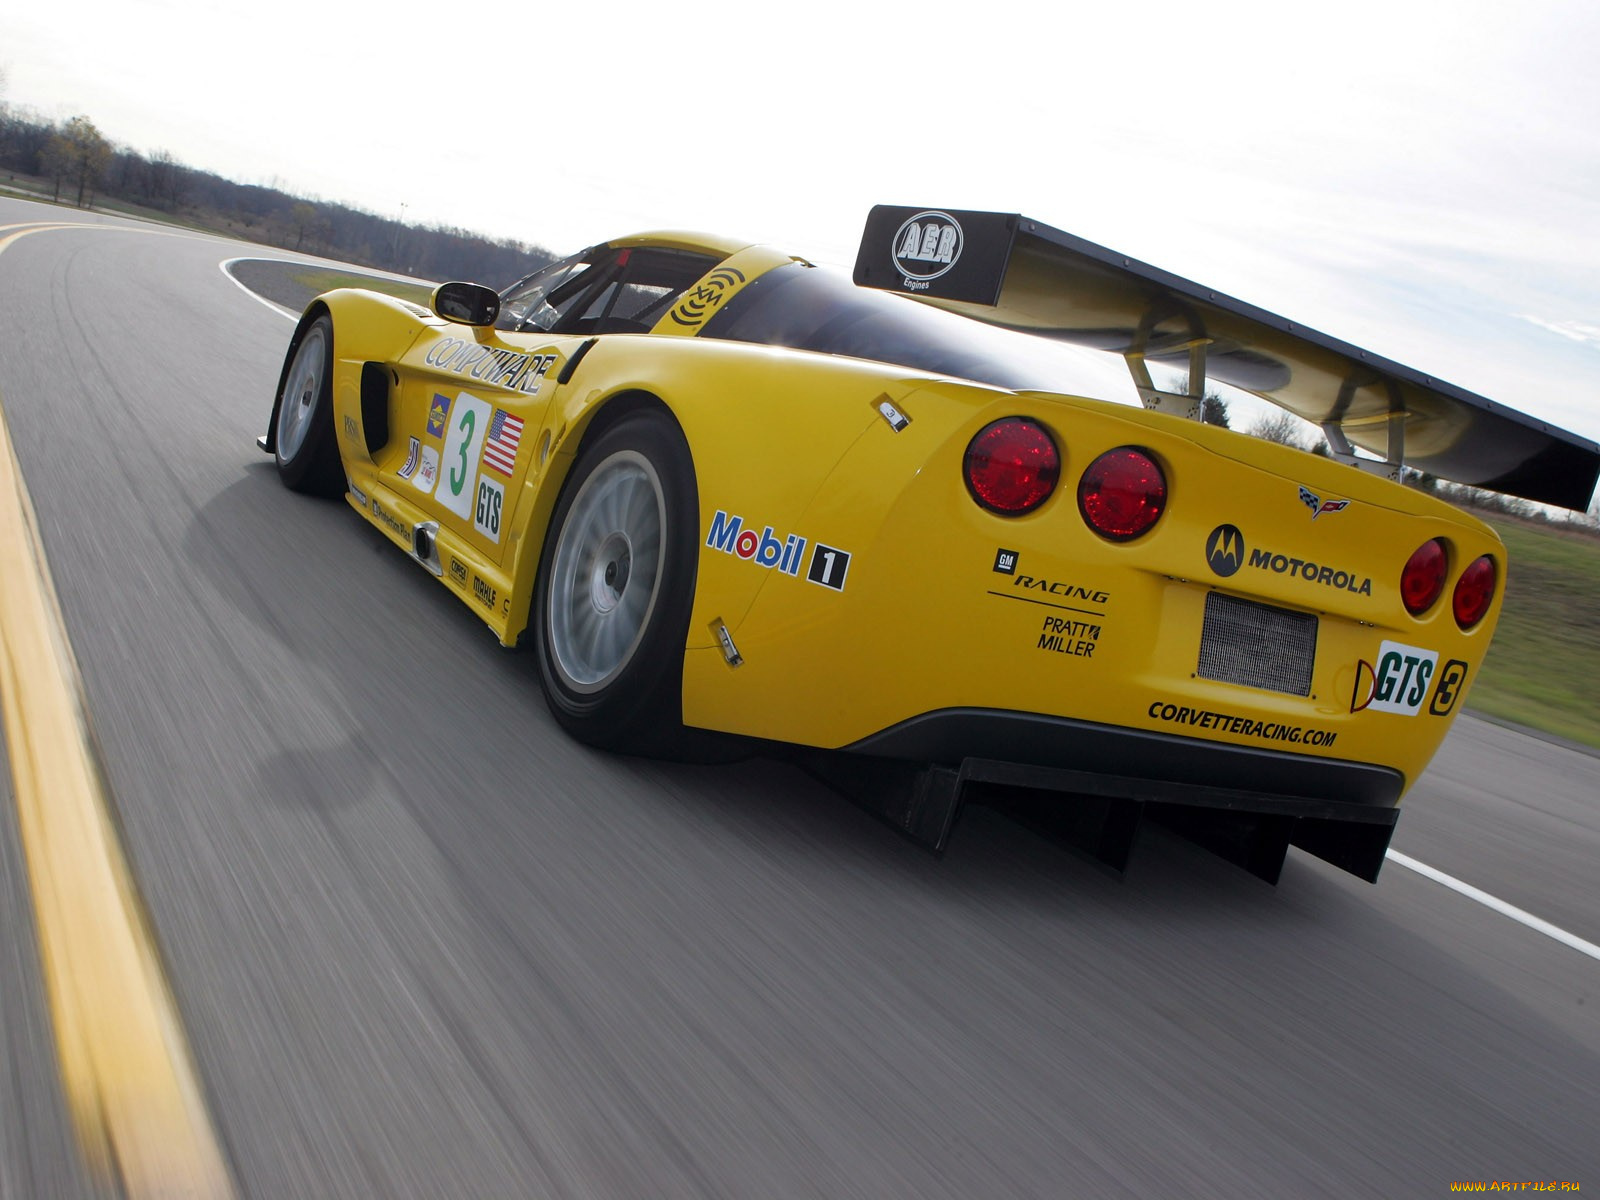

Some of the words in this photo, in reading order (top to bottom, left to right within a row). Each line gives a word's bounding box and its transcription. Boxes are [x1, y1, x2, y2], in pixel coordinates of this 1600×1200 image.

[897, 222, 957, 264] AER
[689, 285, 724, 306] XM
[903, 277, 930, 290] Engines
[424, 337, 558, 396] COMPUWARE
[450, 409, 475, 496] 3
[476, 481, 502, 535] GTS
[705, 509, 808, 577] Mobil
[999, 553, 1014, 567] GM
[473, 576, 496, 606] MAHLE
[1014, 575, 1110, 604] RACING
[1248, 548, 1371, 597] MOTOROLA
[1037, 634, 1095, 658] MILLER
[1043, 616, 1089, 638] PRATT
[1374, 651, 1434, 707] GTS
[1430, 660, 1468, 716] 3
[1148, 701, 1338, 748] CORVETTERACING.COM
